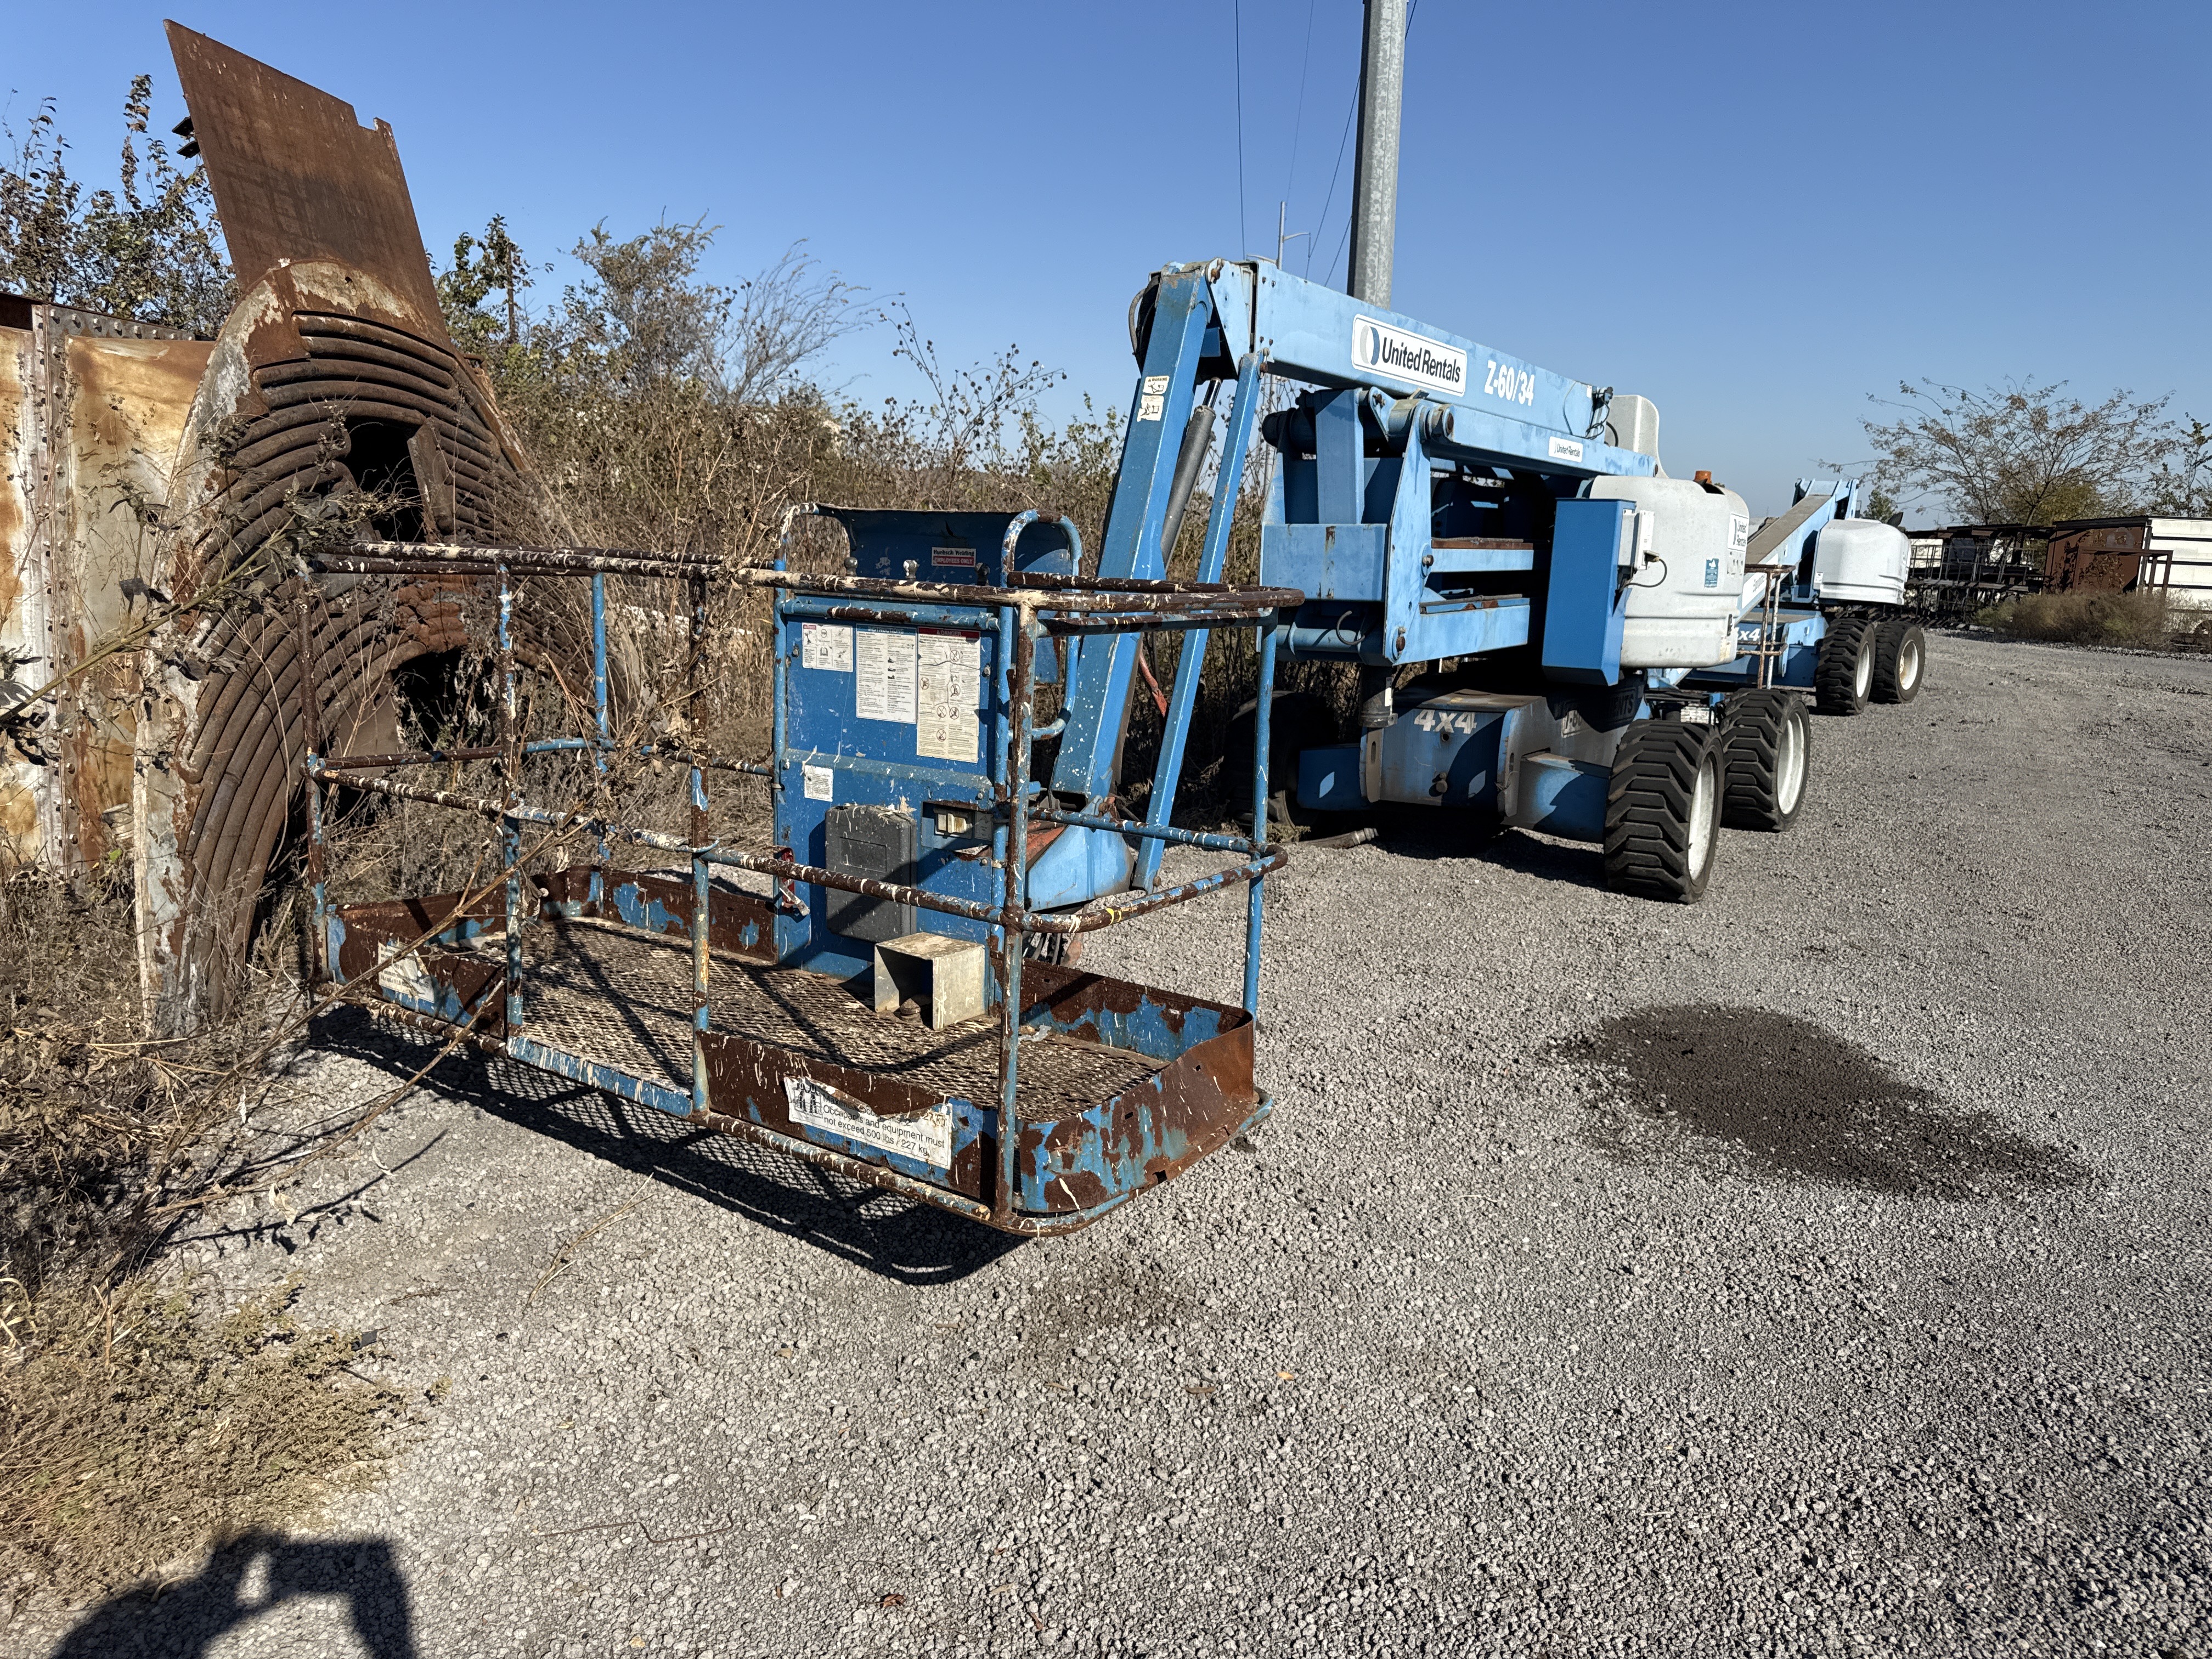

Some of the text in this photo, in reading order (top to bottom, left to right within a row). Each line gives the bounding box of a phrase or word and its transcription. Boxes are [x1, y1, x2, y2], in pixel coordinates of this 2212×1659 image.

[1381, 336, 1461, 383] United Rentals
[1484, 360, 1535, 407] Z-60/34
[1414, 709, 1477, 734] 4x4
[823, 1104, 945, 1148] Occupants and equipment must
[824, 1117, 836, 1126] not
[838, 1121, 864, 1134] exceed
[867, 1128, 881, 1139] 500
[883, 1133, 894, 1144] lbs
[901, 1139, 916, 1150] 227
